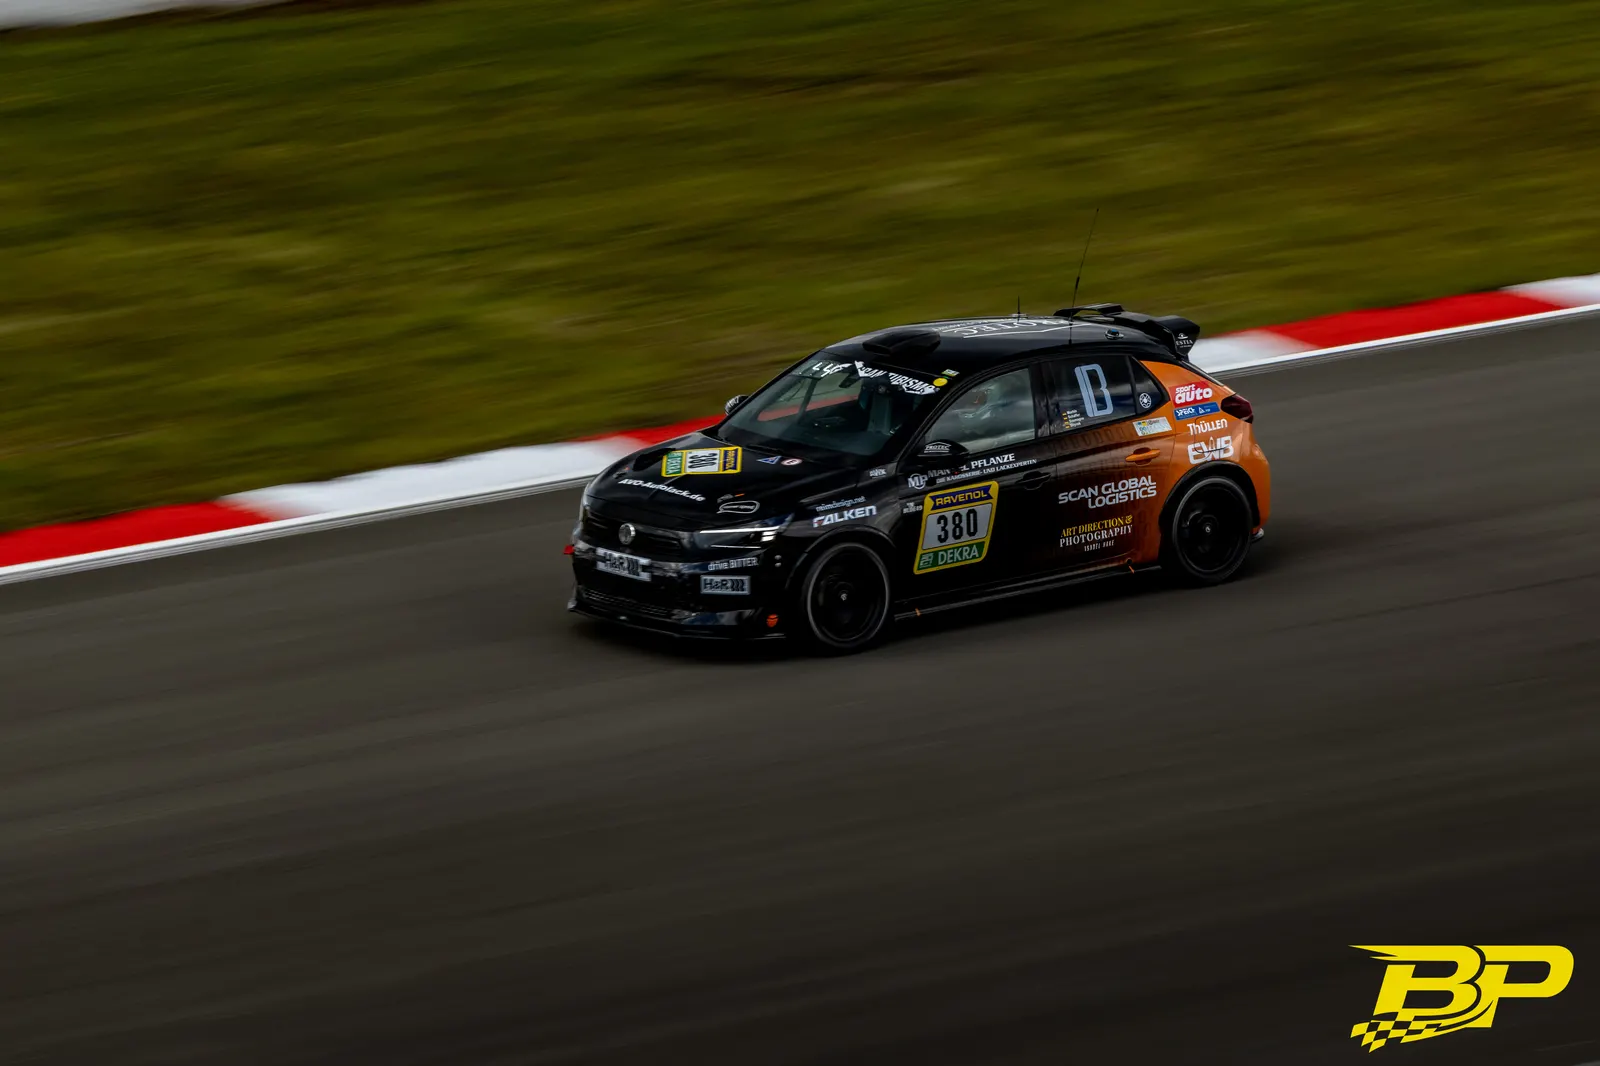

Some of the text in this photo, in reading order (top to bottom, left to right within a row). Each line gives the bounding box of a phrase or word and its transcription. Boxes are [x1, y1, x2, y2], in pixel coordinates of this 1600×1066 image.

[1175, 383, 1196, 394] sport
[1175, 387, 1213, 404] auto
[688, 452, 719, 469] 380
[927, 453, 1016, 478] MANEL PFLANZE
[982, 466, 996, 475] UND
[618, 478, 706, 502] AVO-Autolack.de
[935, 490, 988, 506] RAVENOL
[1058, 475, 1157, 504] SCAN GLOBAL
[1087, 485, 1157, 508] LOGISTICS
[813, 505, 877, 528] FALKEN
[936, 508, 978, 543] 380
[1060, 526, 1078, 538] ART
[1078, 516, 1124, 534] DIRECTION
[1059, 524, 1133, 548] PHOTOGRAPHY
[707, 560, 729, 571] drive
[937, 544, 979, 565] DEKRA
